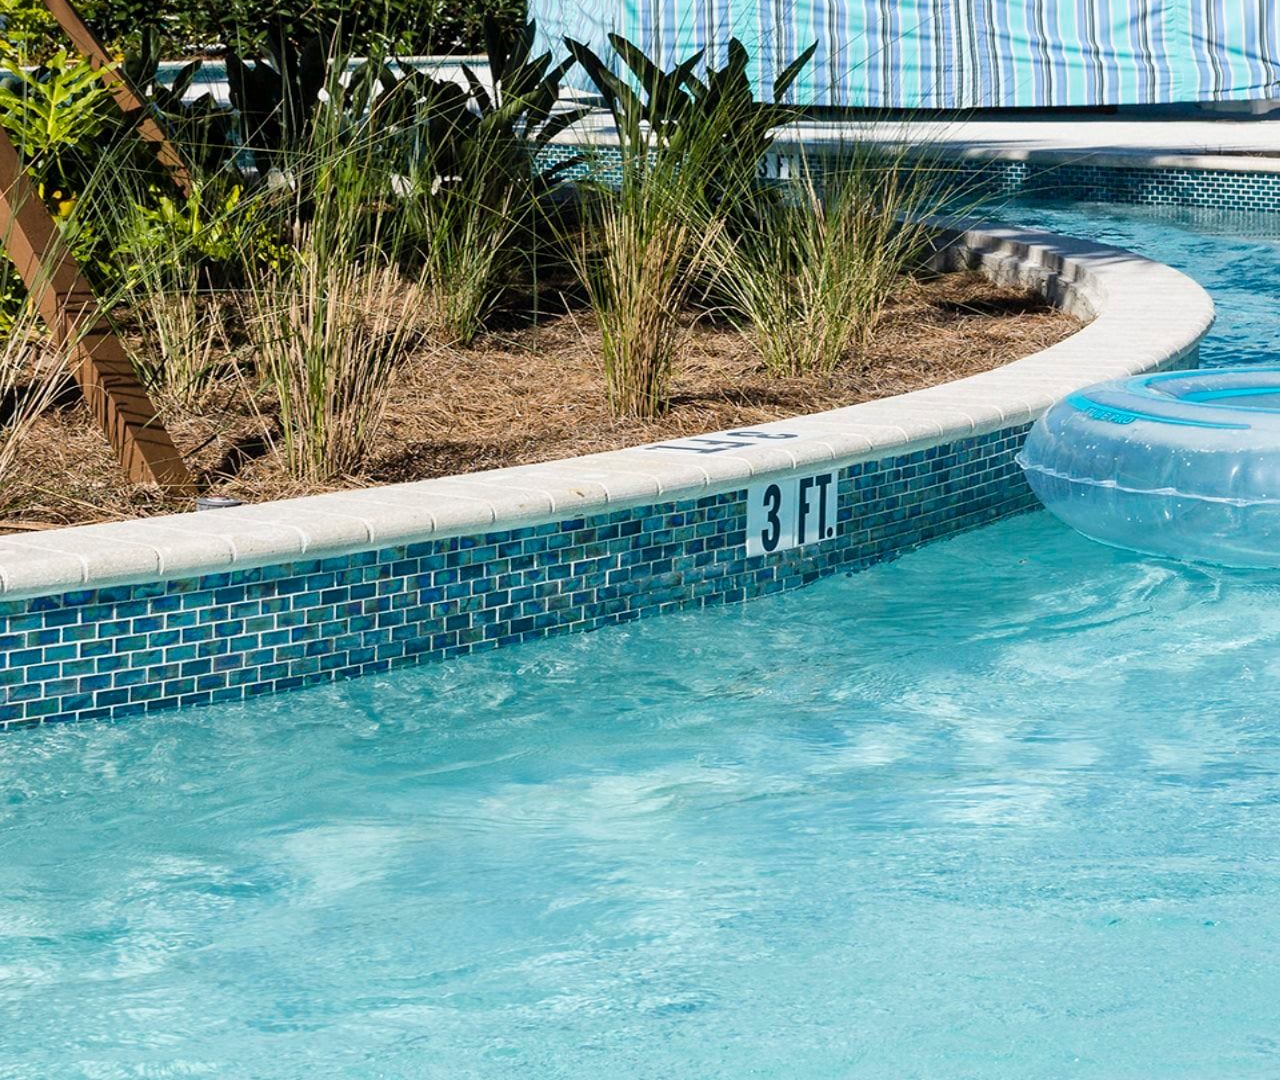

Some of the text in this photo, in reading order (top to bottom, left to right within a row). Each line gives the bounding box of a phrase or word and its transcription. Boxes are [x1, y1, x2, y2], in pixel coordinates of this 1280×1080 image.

[759, 152, 768, 177] 3
[726, 431, 798, 439] 3
[761, 474, 834, 551] 3 FT.
